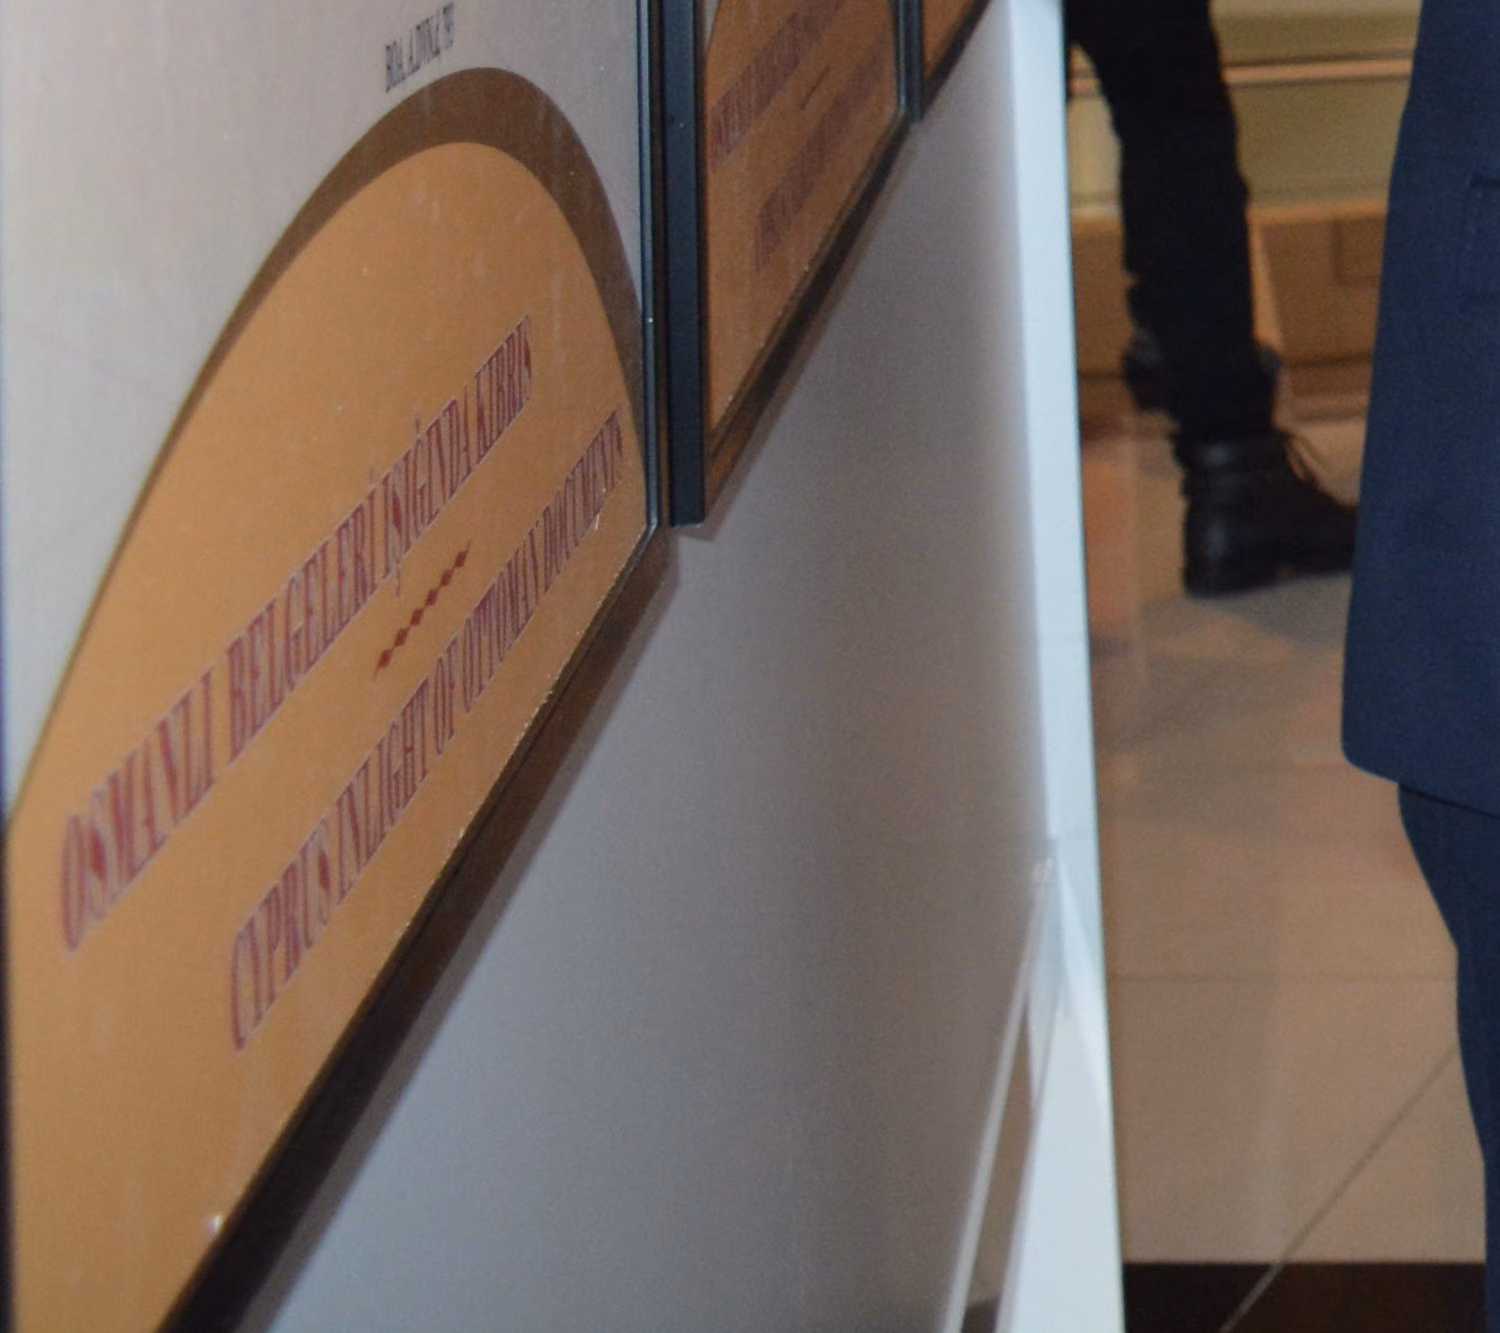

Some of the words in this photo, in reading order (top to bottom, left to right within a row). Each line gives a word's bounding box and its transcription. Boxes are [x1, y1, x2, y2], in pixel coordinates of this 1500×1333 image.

[60, 661, 214, 961] OSMANLI
[225, 469, 377, 768] BELGELERİ
[381, 379, 472, 591] IŞIĞINDA
[474, 310, 531, 466] KIBRIS
[230, 807, 329, 1051] CYPRUS
[434, 632, 457, 762] OF
[462, 516, 540, 721] OTTOMAN
[543, 400, 624, 596] DOCUMENTS
